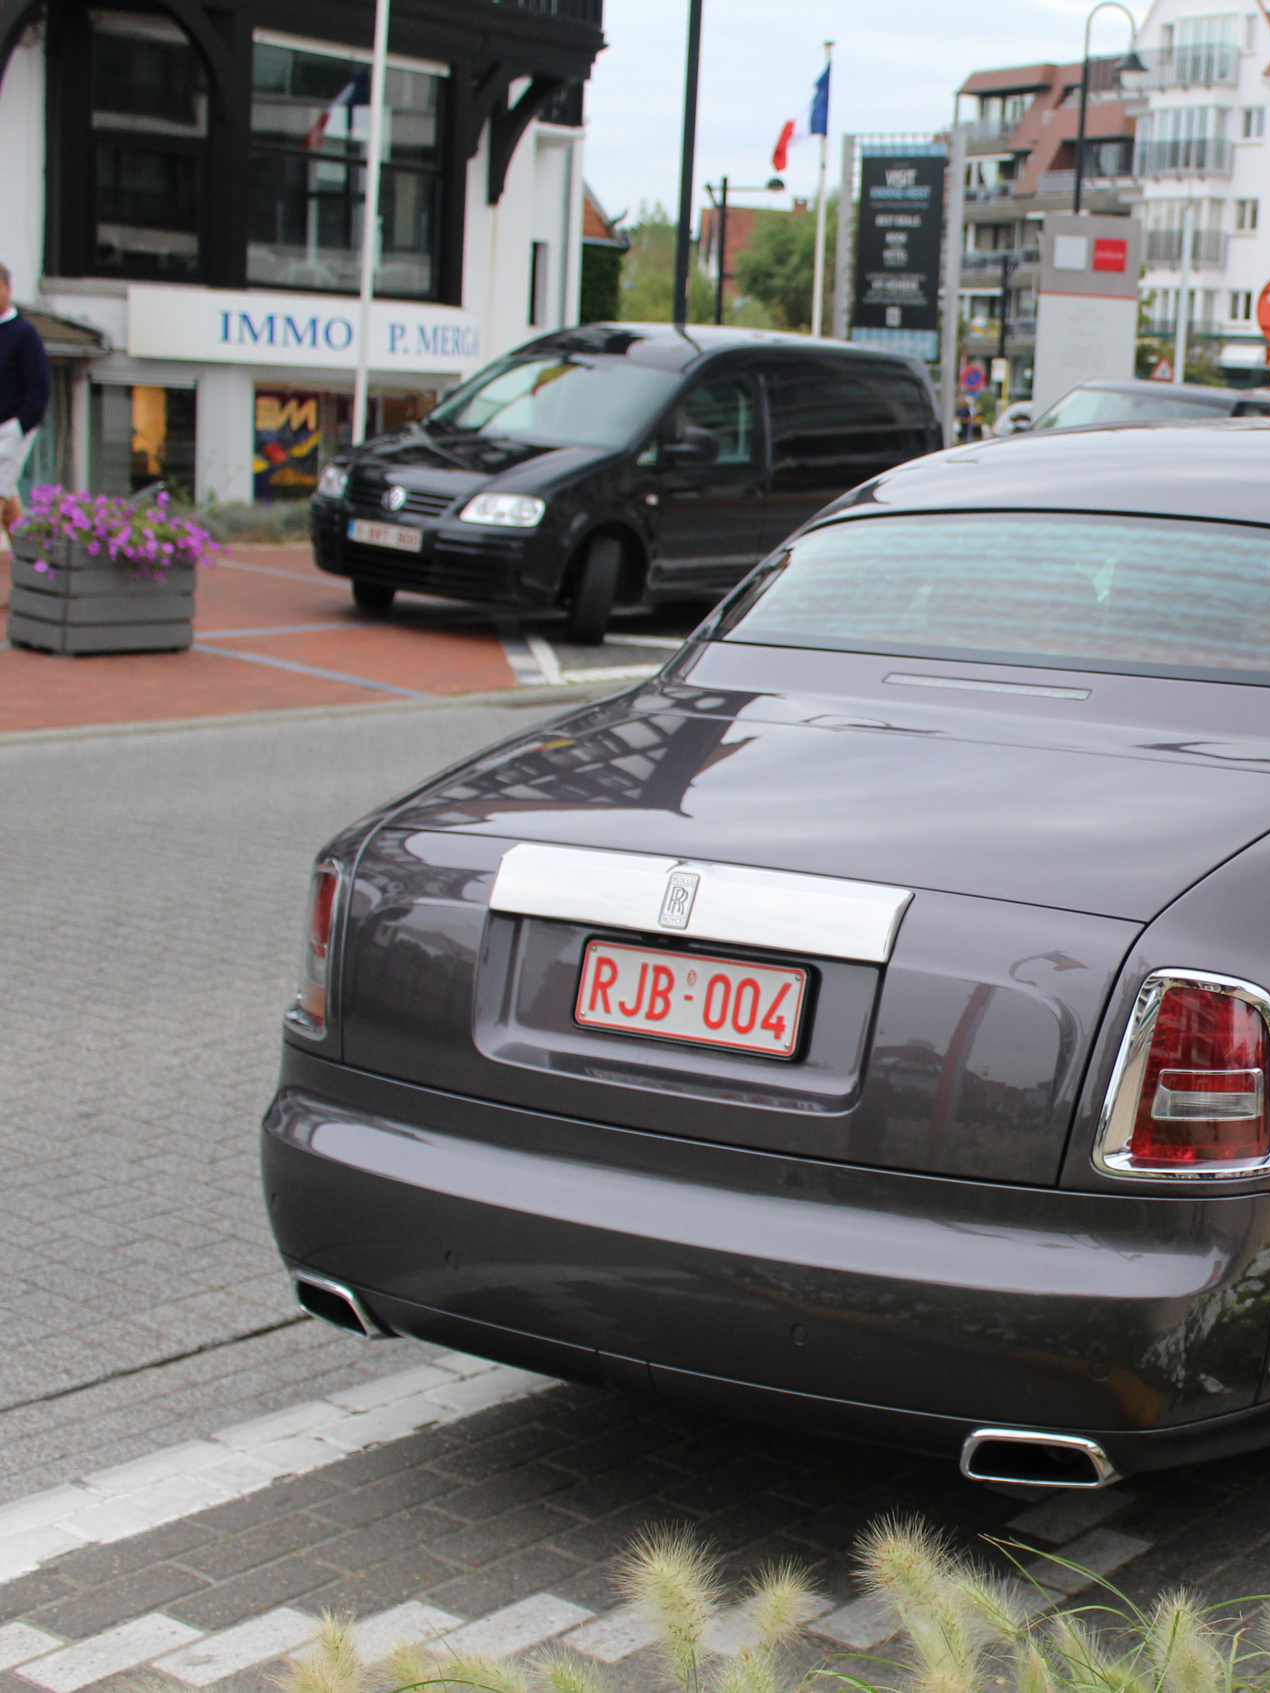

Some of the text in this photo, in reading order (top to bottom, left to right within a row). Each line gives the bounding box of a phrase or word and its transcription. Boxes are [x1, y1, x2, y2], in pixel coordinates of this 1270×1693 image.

[886, 169, 917, 187] VISIT
[219, 311, 353, 351] IMMO
[388, 323, 408, 354] P.
[672, 876, 696, 886] ROLLS
[661, 916, 684, 926] ROYCE
[588, 955, 792, 1040] RJB-004
